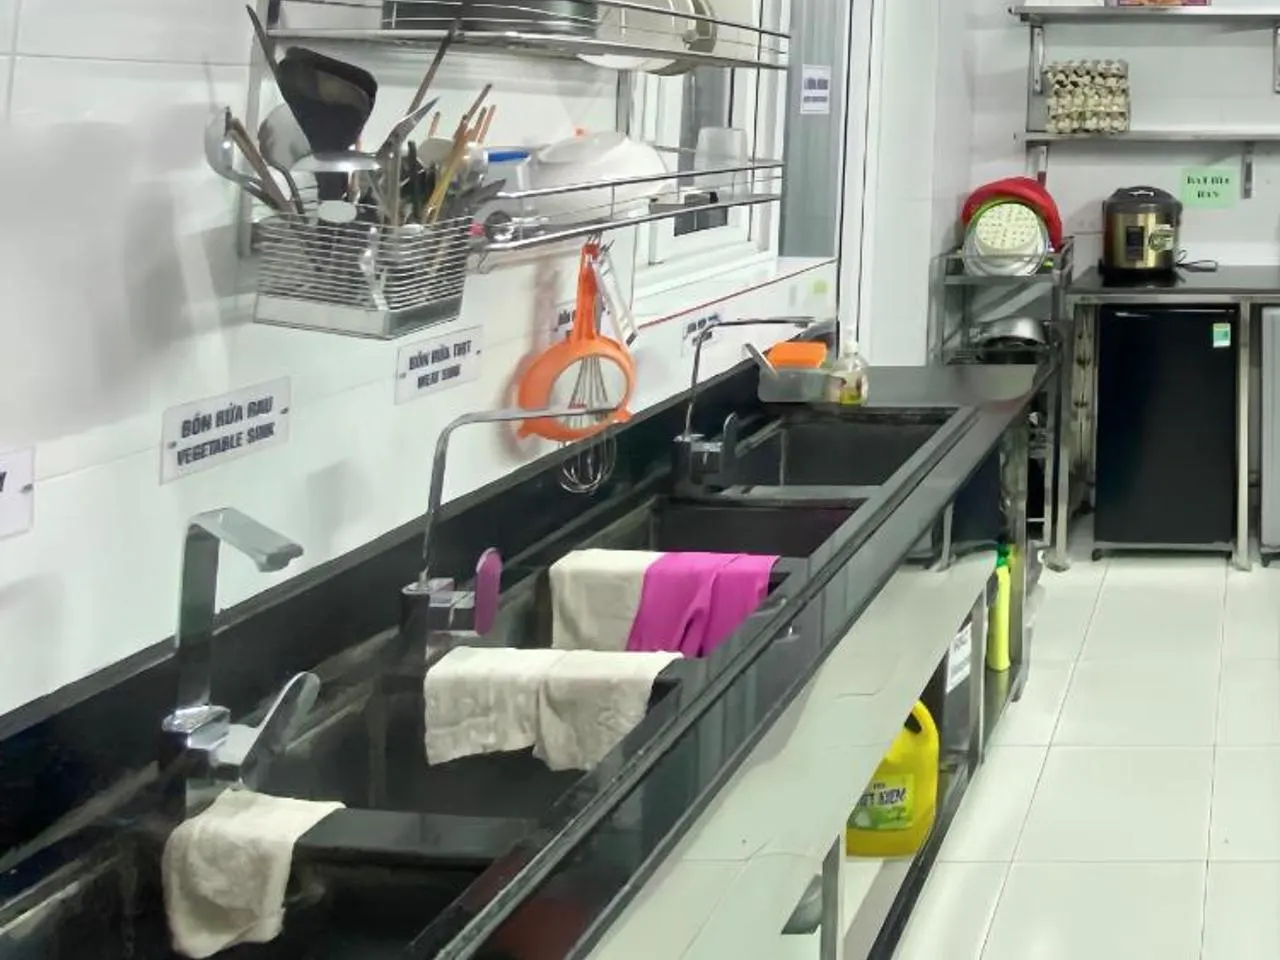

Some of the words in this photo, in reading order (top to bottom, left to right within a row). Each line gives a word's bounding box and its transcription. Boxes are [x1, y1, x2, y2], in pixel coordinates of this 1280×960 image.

[246, 396, 274, 419] RAU
[176, 431, 243, 467] VEGETABLE
[246, 422, 275, 445] SINK
